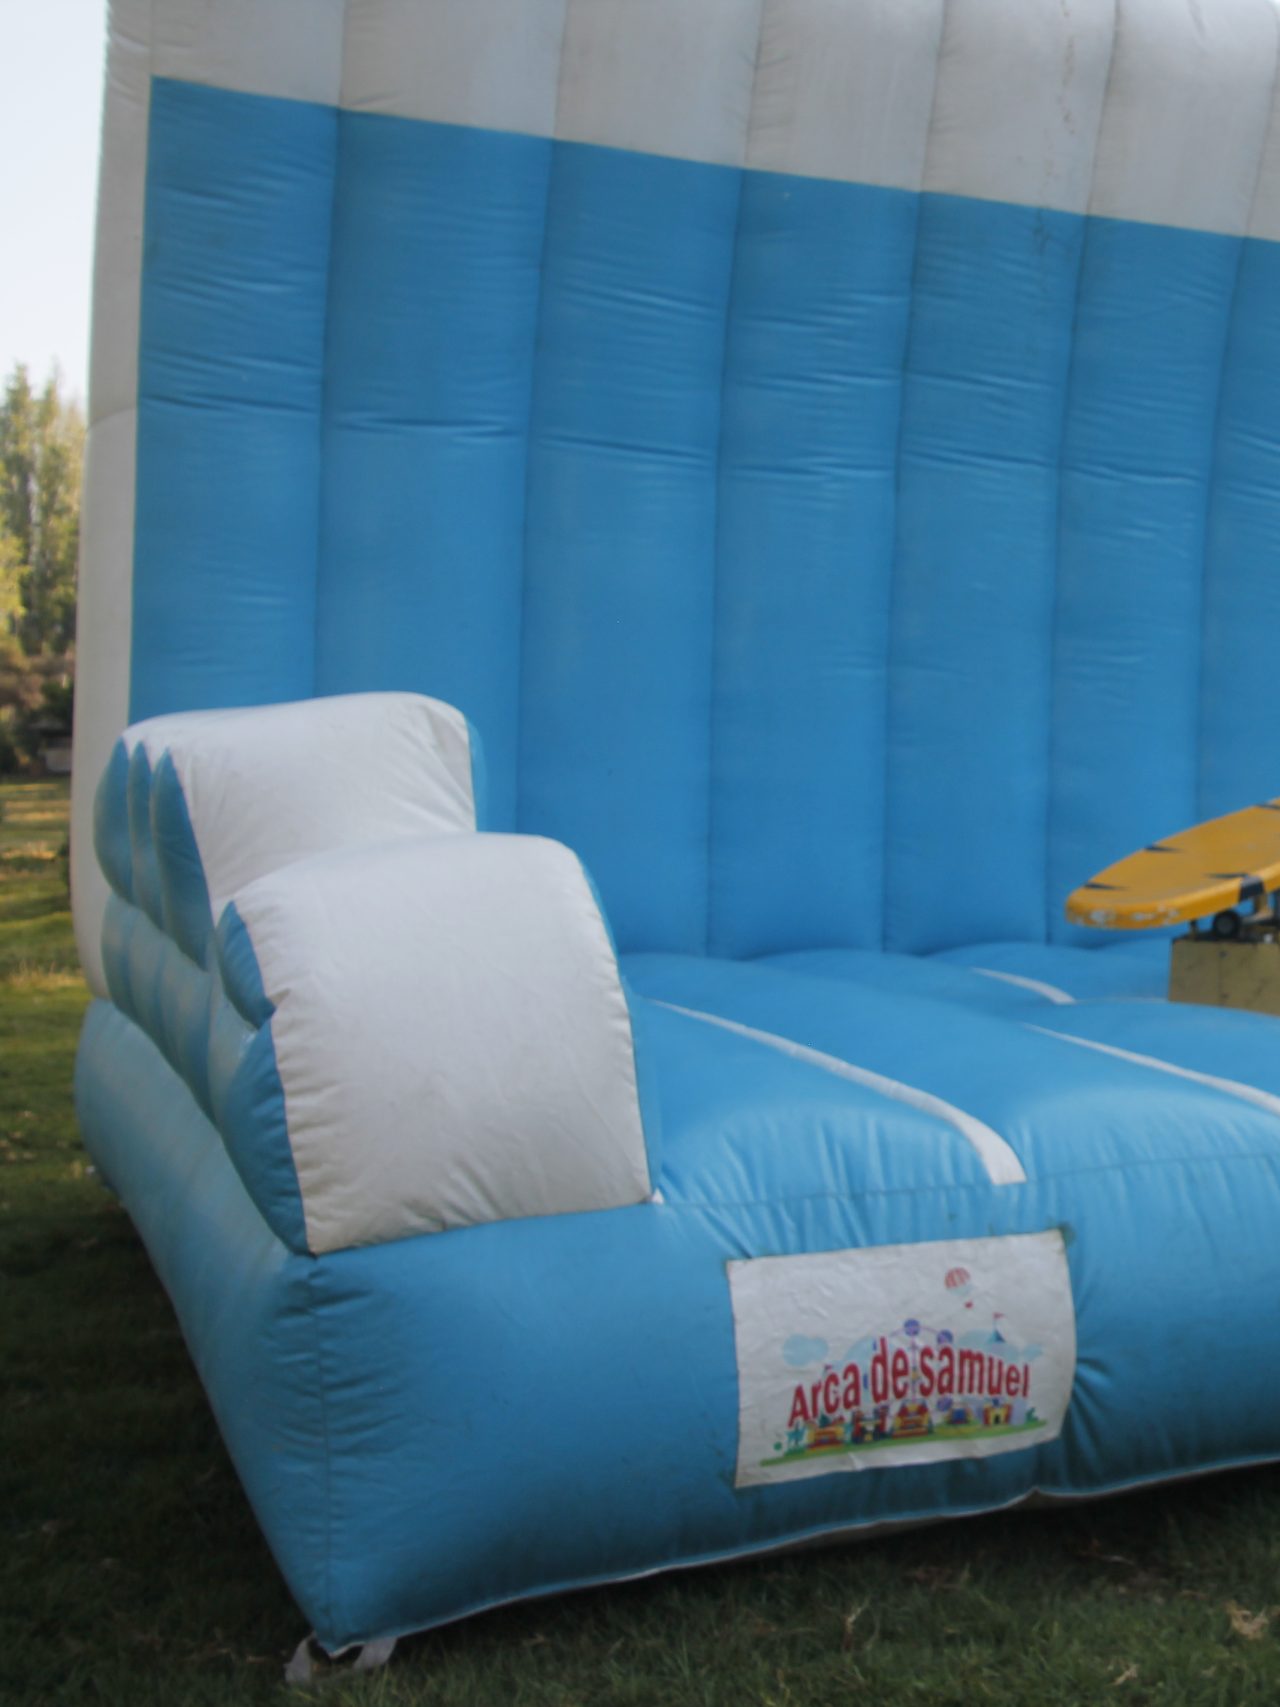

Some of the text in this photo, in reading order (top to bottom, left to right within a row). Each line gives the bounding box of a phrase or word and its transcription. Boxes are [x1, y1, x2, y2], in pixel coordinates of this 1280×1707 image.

[787, 1336, 1031, 1428] Arca de samuel
